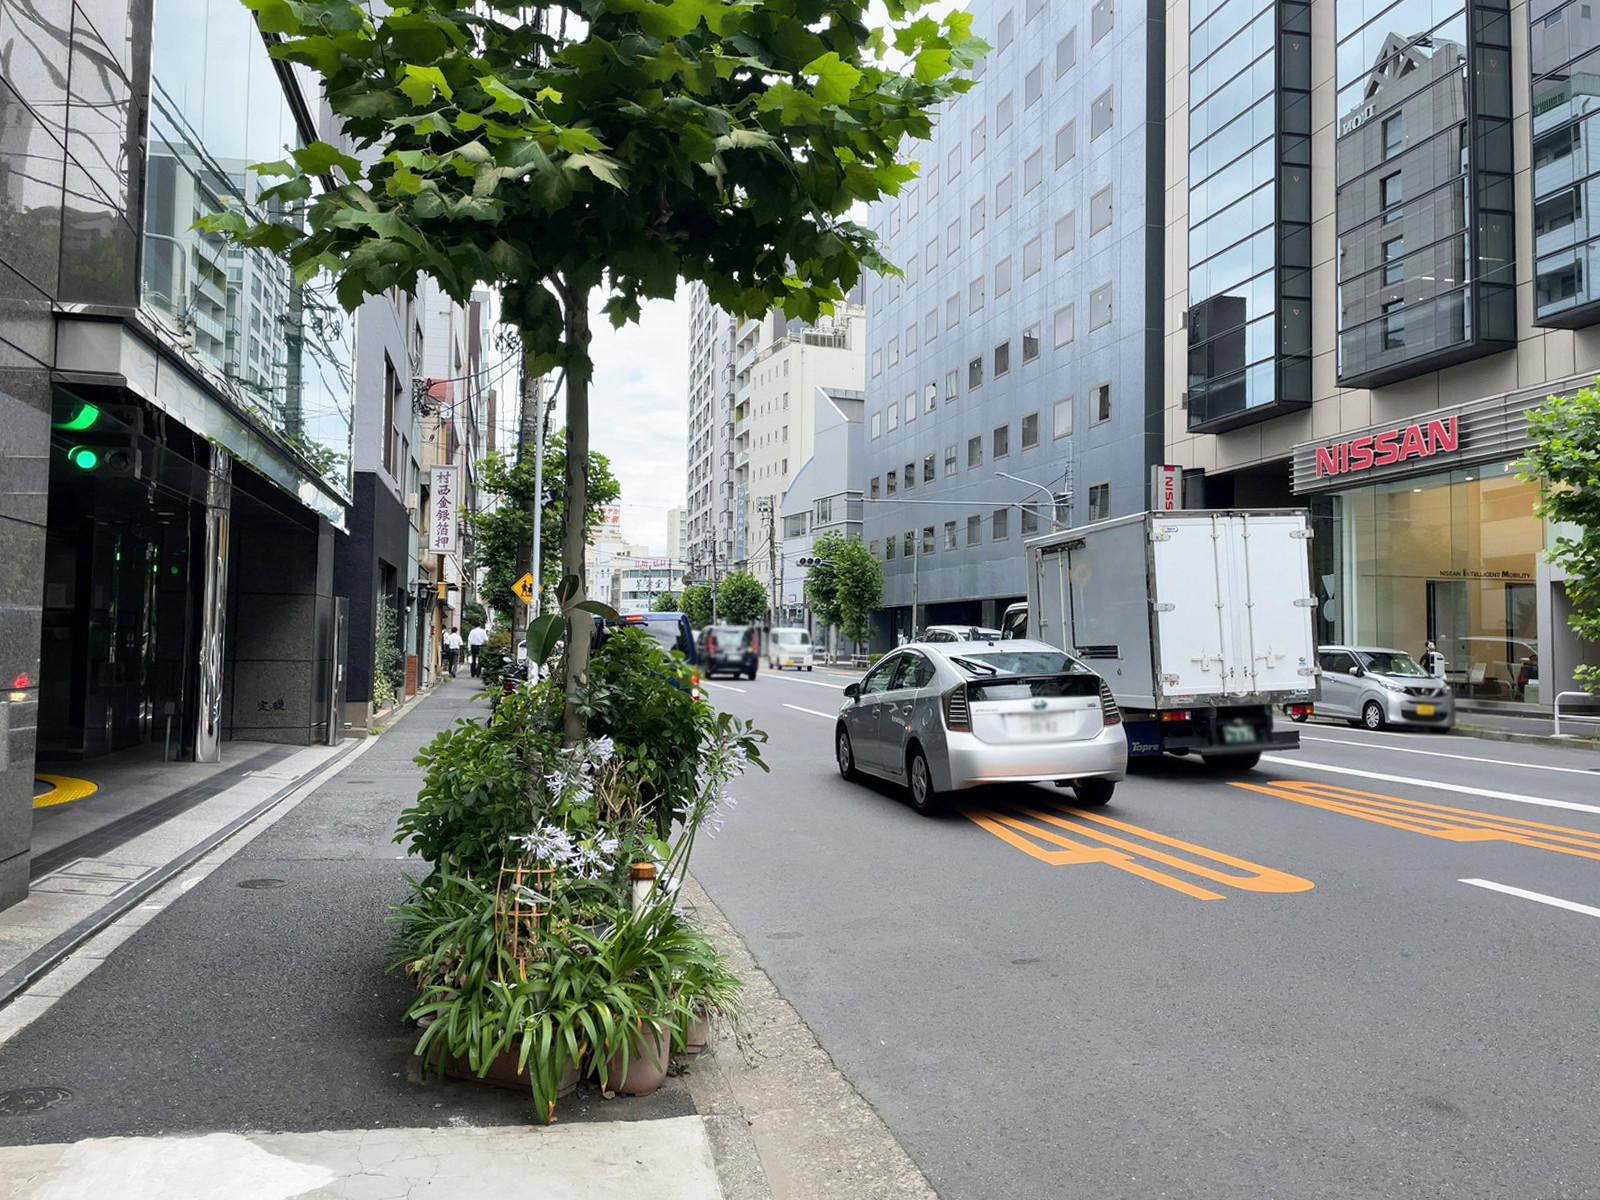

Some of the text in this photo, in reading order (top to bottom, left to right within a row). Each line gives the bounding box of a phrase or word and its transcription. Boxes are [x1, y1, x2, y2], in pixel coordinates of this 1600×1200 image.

[1315, 415, 1460, 477] NISSAN
[434, 471, 452, 548] 村西金銀箔押
[1165, 477, 1174, 510] NISS
[1131, 741, 1160, 753] Topre
